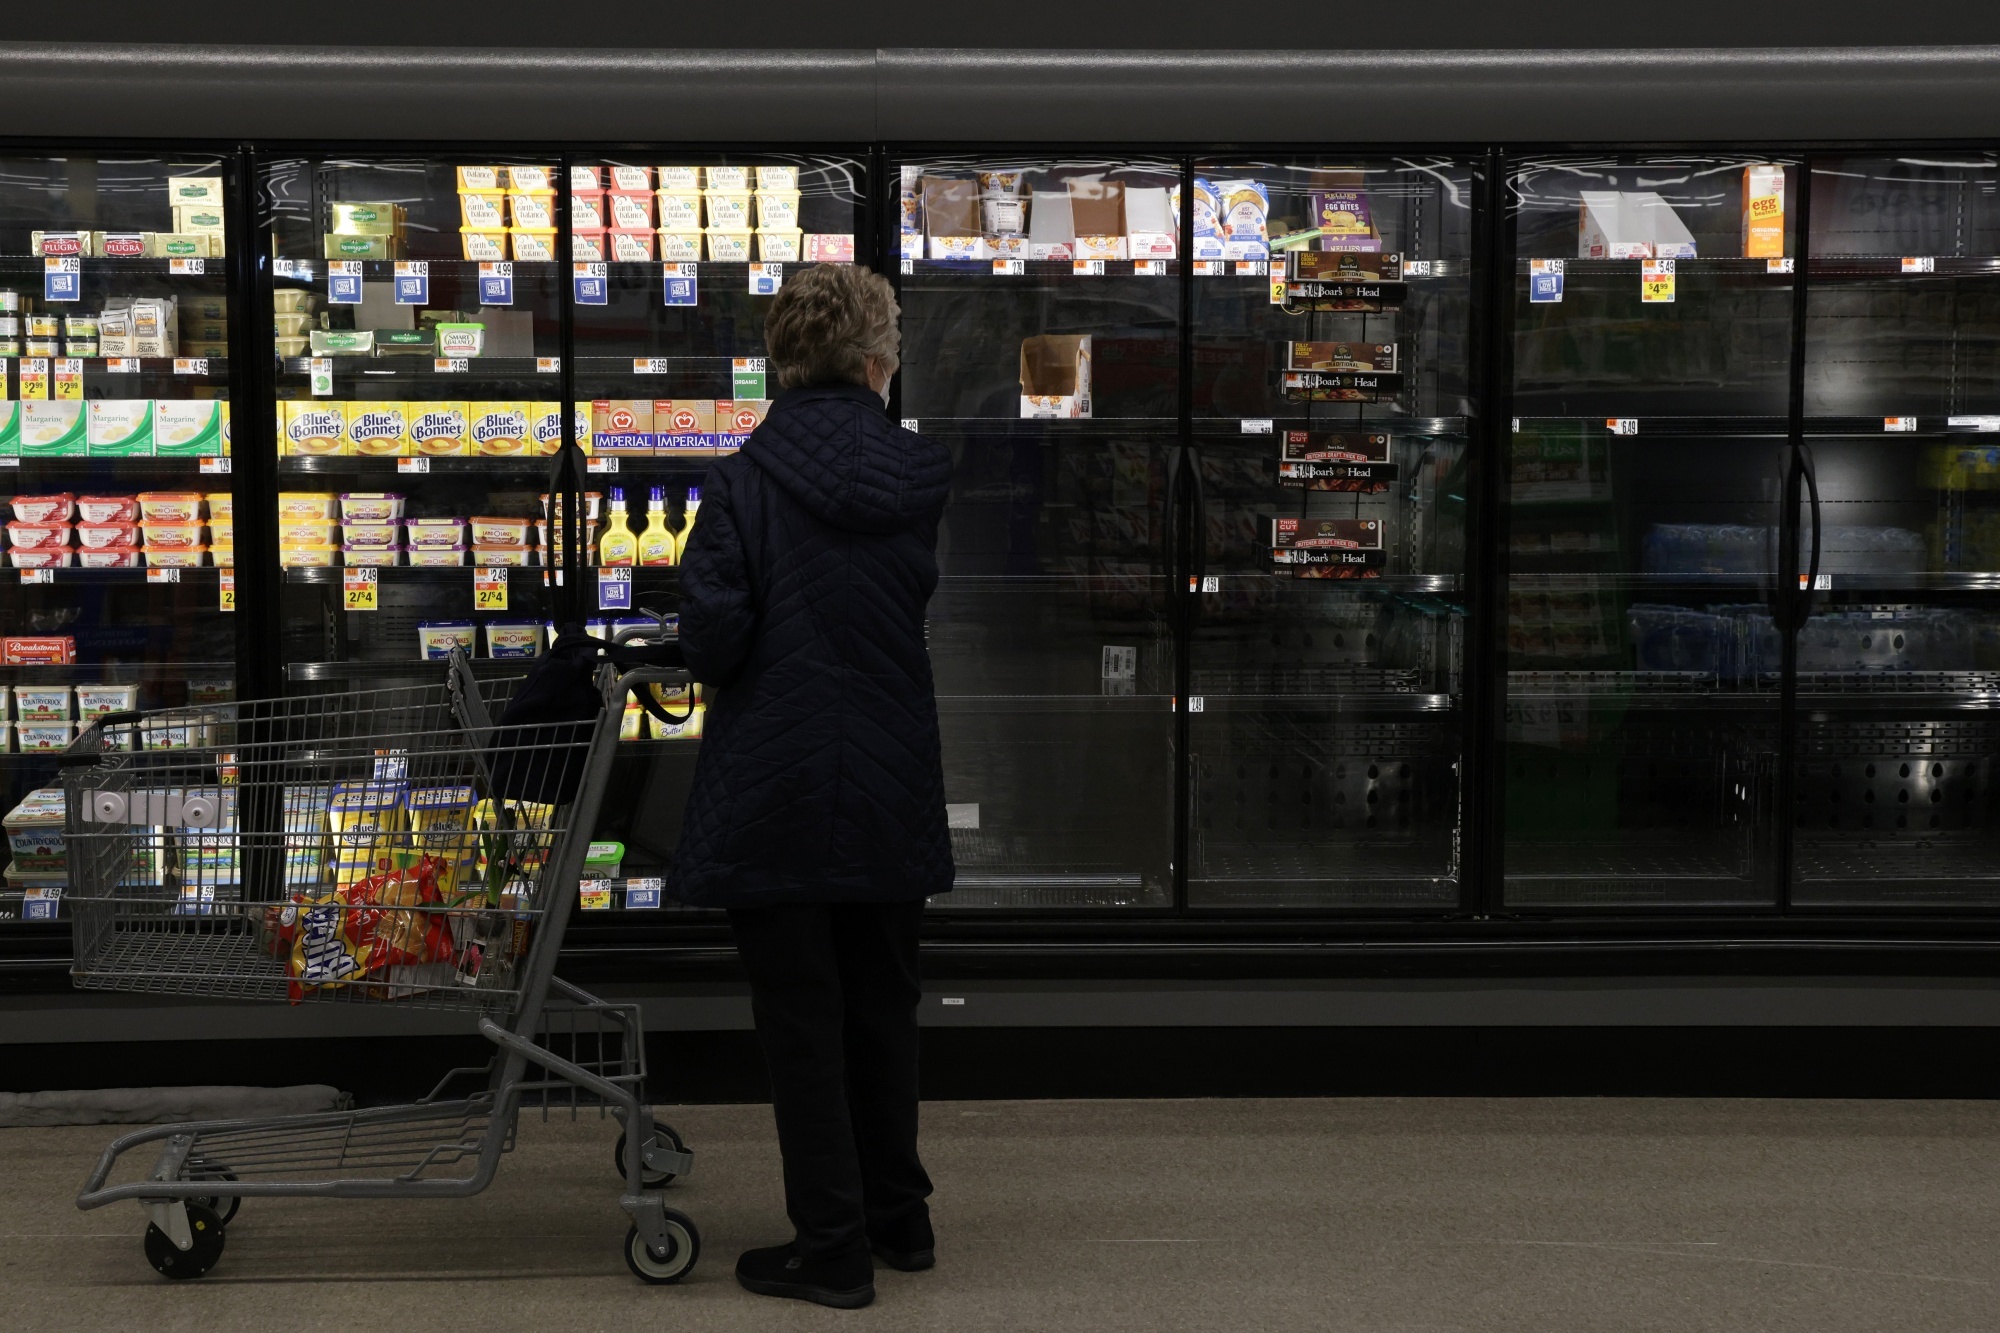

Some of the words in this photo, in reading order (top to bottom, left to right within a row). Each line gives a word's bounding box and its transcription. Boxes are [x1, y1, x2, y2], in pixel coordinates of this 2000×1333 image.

[1325, 203, 1340, 211] EGG
[1341, 203, 1360, 211] BITES
[1752, 197, 1777, 211] egg
[471, 210, 496, 218] balance
[520, 210, 545, 218] balance
[668, 211, 693, 219] balance
[1754, 209, 1777, 217] beaters
[44, 242, 79, 251] PLUGRÁ
[107, 242, 141, 251] PLUGRÁ
[341, 243, 369, 252] Kerrygold
[521, 249, 545, 257] balance
[62, 259, 79, 272] $2.69
[186, 260, 204, 273] $4.49
[344, 262, 361, 275] $4.49
[410, 262, 427, 275] $4.49
[495, 263, 511, 276] $4.99
[589, 265, 606, 276] $4.99
[680, 264, 696, 276] $4.99
[765, 264, 782, 277] $4.99
[1413, 261, 1428, 275] $4.59
[1547, 261, 1563, 274] $4.59
[1658, 260, 1674, 273] $5.49
[1319, 286, 1343, 296] Boar's
[1356, 287, 1380, 297] Head
[1649, 283, 1668, 294] $4.99
[33, 358, 44, 372] $3.49
[67, 359, 79, 372] $3.49
[191, 360, 208, 374] $4.59
[451, 360, 468, 373] $3.69
[650, 360, 667, 373] $3.69
[748, 359, 765, 372] $3.69
[25, 382, 43, 393] $2.99
[60, 382, 78, 393] $2.99
[1318, 377, 1341, 386] Boar's
[1354, 378, 1377, 387] Head
[25, 415, 63, 424] Margarine
[93, 414, 129, 423] Margarine
[159, 415, 196, 424] Margarine
[302, 414, 330, 426] Blue
[363, 413, 391, 426] Blue
[424, 414, 452, 426] Blue
[486, 414, 514, 426] Blue
[293, 424, 341, 438] Bonnet
[354, 425, 401, 438] Bonnet
[415, 425, 462, 438] Bonnet
[477, 425, 523, 438] Bonnet
[595, 434, 651, 447] IMPERIAL
[657, 434, 712, 447] IMPERIAL
[1311, 466, 1334, 476] Boar's
[1347, 468, 1371, 477] Head
[1306, 553, 1328, 562] Boar's
[1342, 554, 1366, 563] Head
[360, 568, 377, 581] $2.49
[490, 568, 507, 581] $2.49
[615, 568, 630, 581] $3.29
[10, 641, 61, 653] Breakstone's
[660, 727, 685, 738] Butter!
[643, 879, 660, 890] $3.39
[43, 888, 60, 899] $4.59
[584, 896, 603, 904] $5.99
